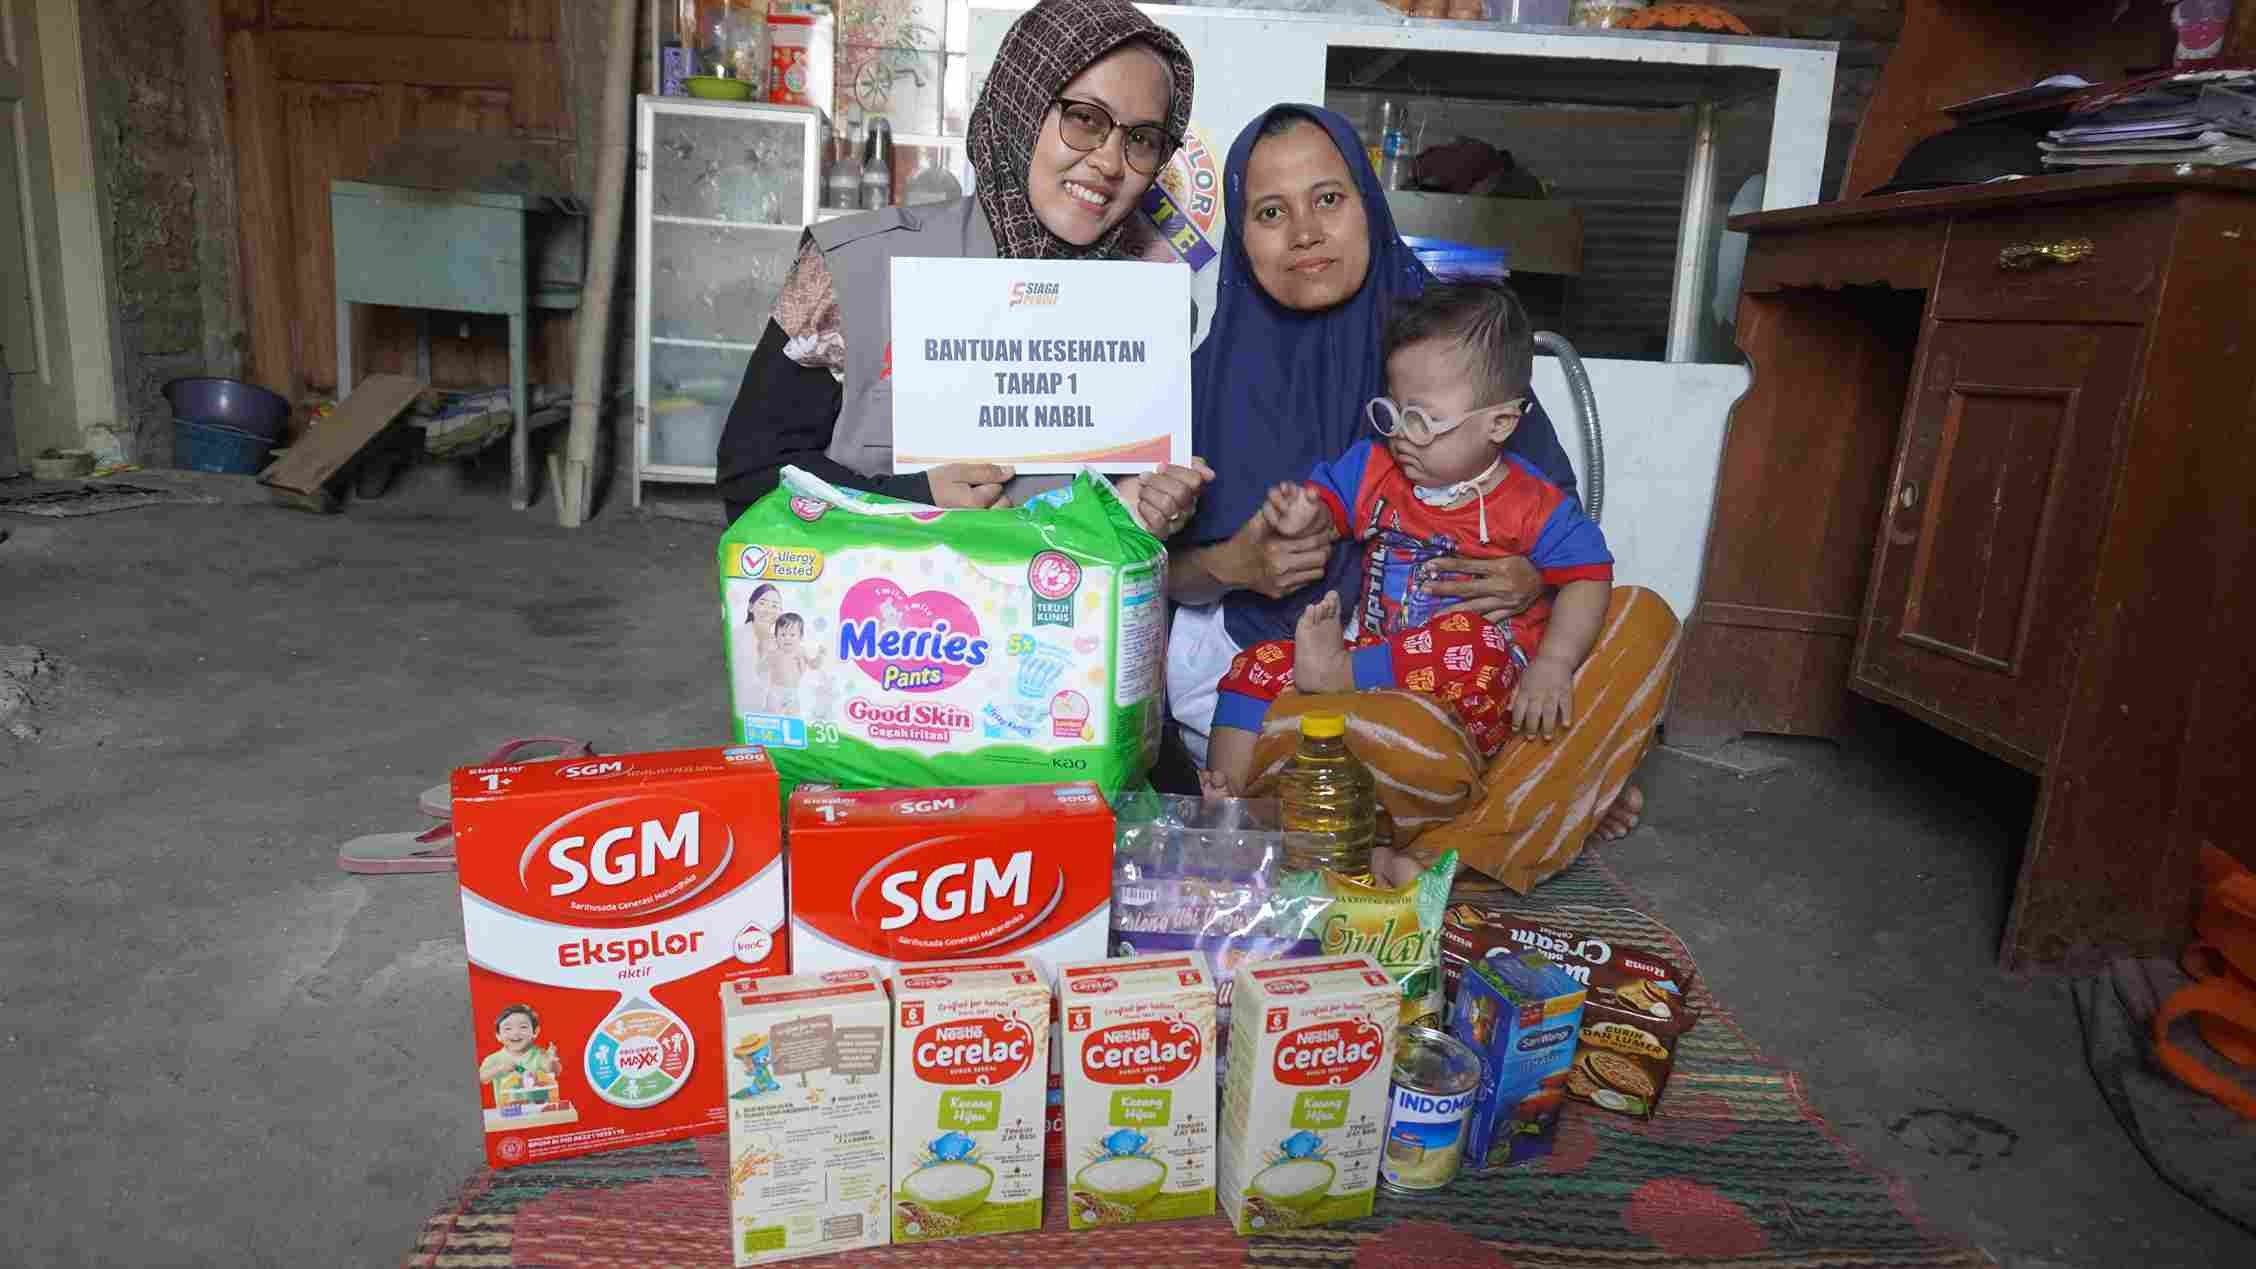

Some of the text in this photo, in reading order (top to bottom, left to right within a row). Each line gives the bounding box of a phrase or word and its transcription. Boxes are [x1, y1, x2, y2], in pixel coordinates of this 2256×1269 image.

[1025, 282, 1060, 295] SIAGA
[924, 338, 1146, 362] BANTUAN KESEHATAN
[994, 372, 1078, 395] TAHAP 1
[978, 405, 1095, 428] ADIK NABIL
[773, 551, 817, 565] Allergy
[773, 564, 813, 576] Tested
[840, 620, 989, 666] Merries
[882, 664, 944, 691] Pants
[849, 700, 911, 722] Good
[914, 705, 972, 728] Skin
[784, 719, 801, 745] L
[816, 720, 840, 743] 30
[565, 760, 622, 778] SGM
[480, 775, 513, 791] 1+
[900, 798, 955, 814] SGM
[548, 811, 699, 897] SGM
[880, 850, 1032, 931] SGM
[558, 930, 704, 968] Eksplor
[1509, 928, 1612, 965] Cream
[618, 967, 651, 980] Aktif
[1624, 959, 1665, 978] Roma
[909, 1008, 918, 1021] 6
[936, 1026, 984, 1041] Nestlé
[619, 1053, 658, 1069] MAXX
[917, 1038, 1025, 1068] Cerelac
[1086, 1040, 1192, 1069] Cerelac
[1278, 1040, 1376, 1071] Cerelac
